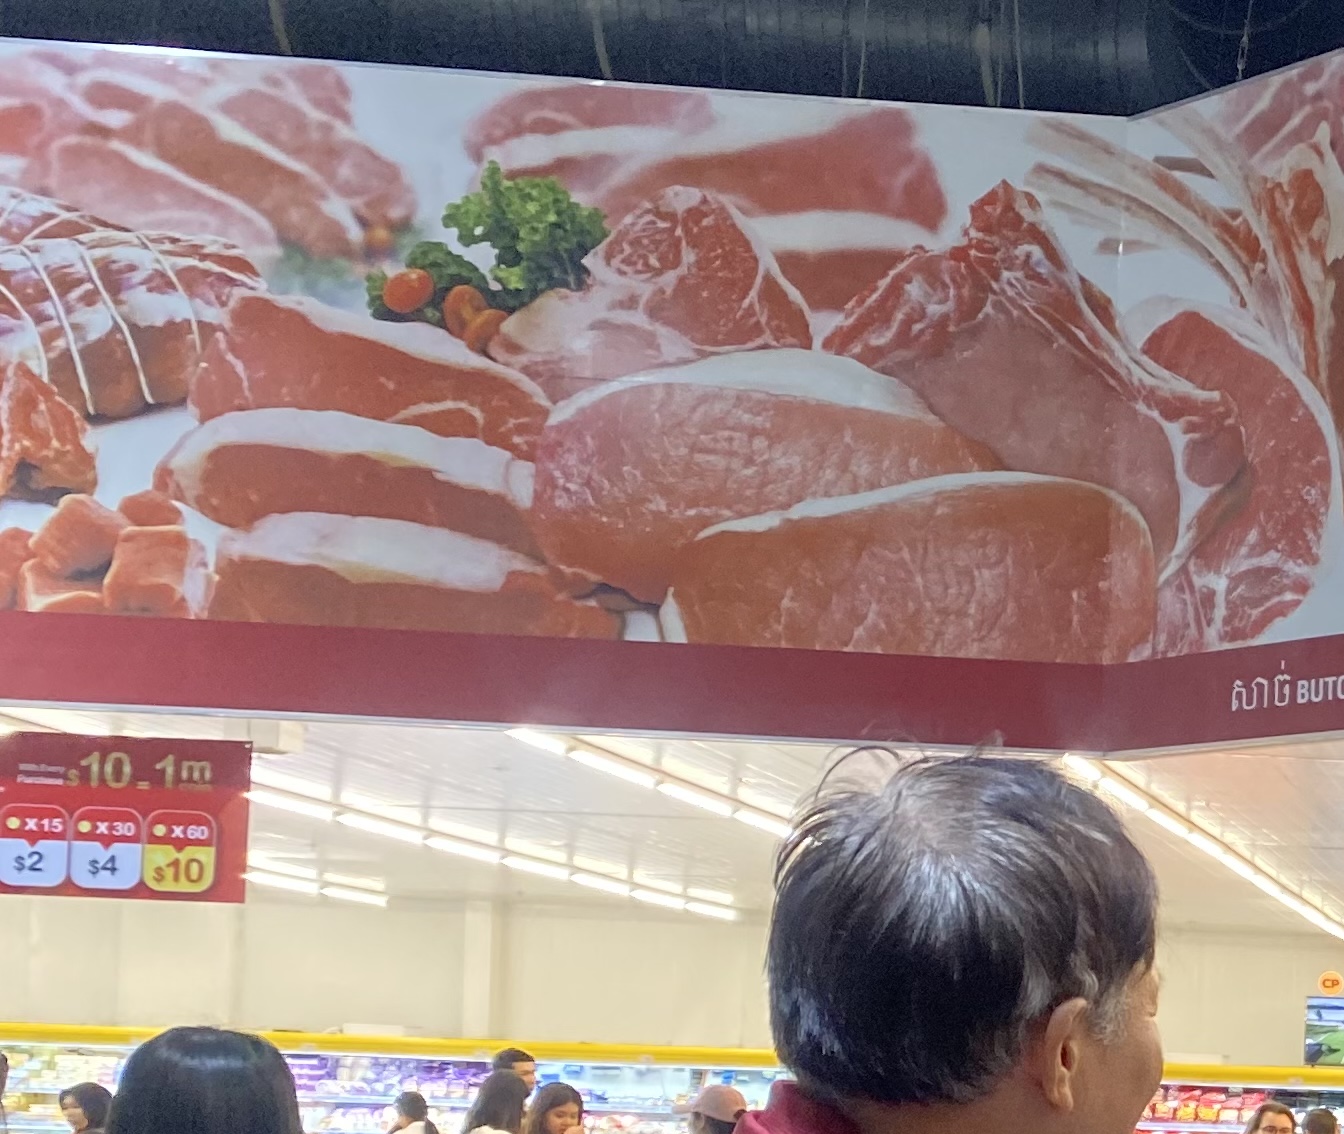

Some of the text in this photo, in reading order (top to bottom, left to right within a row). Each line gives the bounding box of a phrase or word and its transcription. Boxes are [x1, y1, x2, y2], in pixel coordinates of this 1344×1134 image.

[13, 851, 44, 873] $2
[88, 855, 118, 877] $4
[152, 858, 204, 883] $10
[1322, 979, 1340, 988] CP
